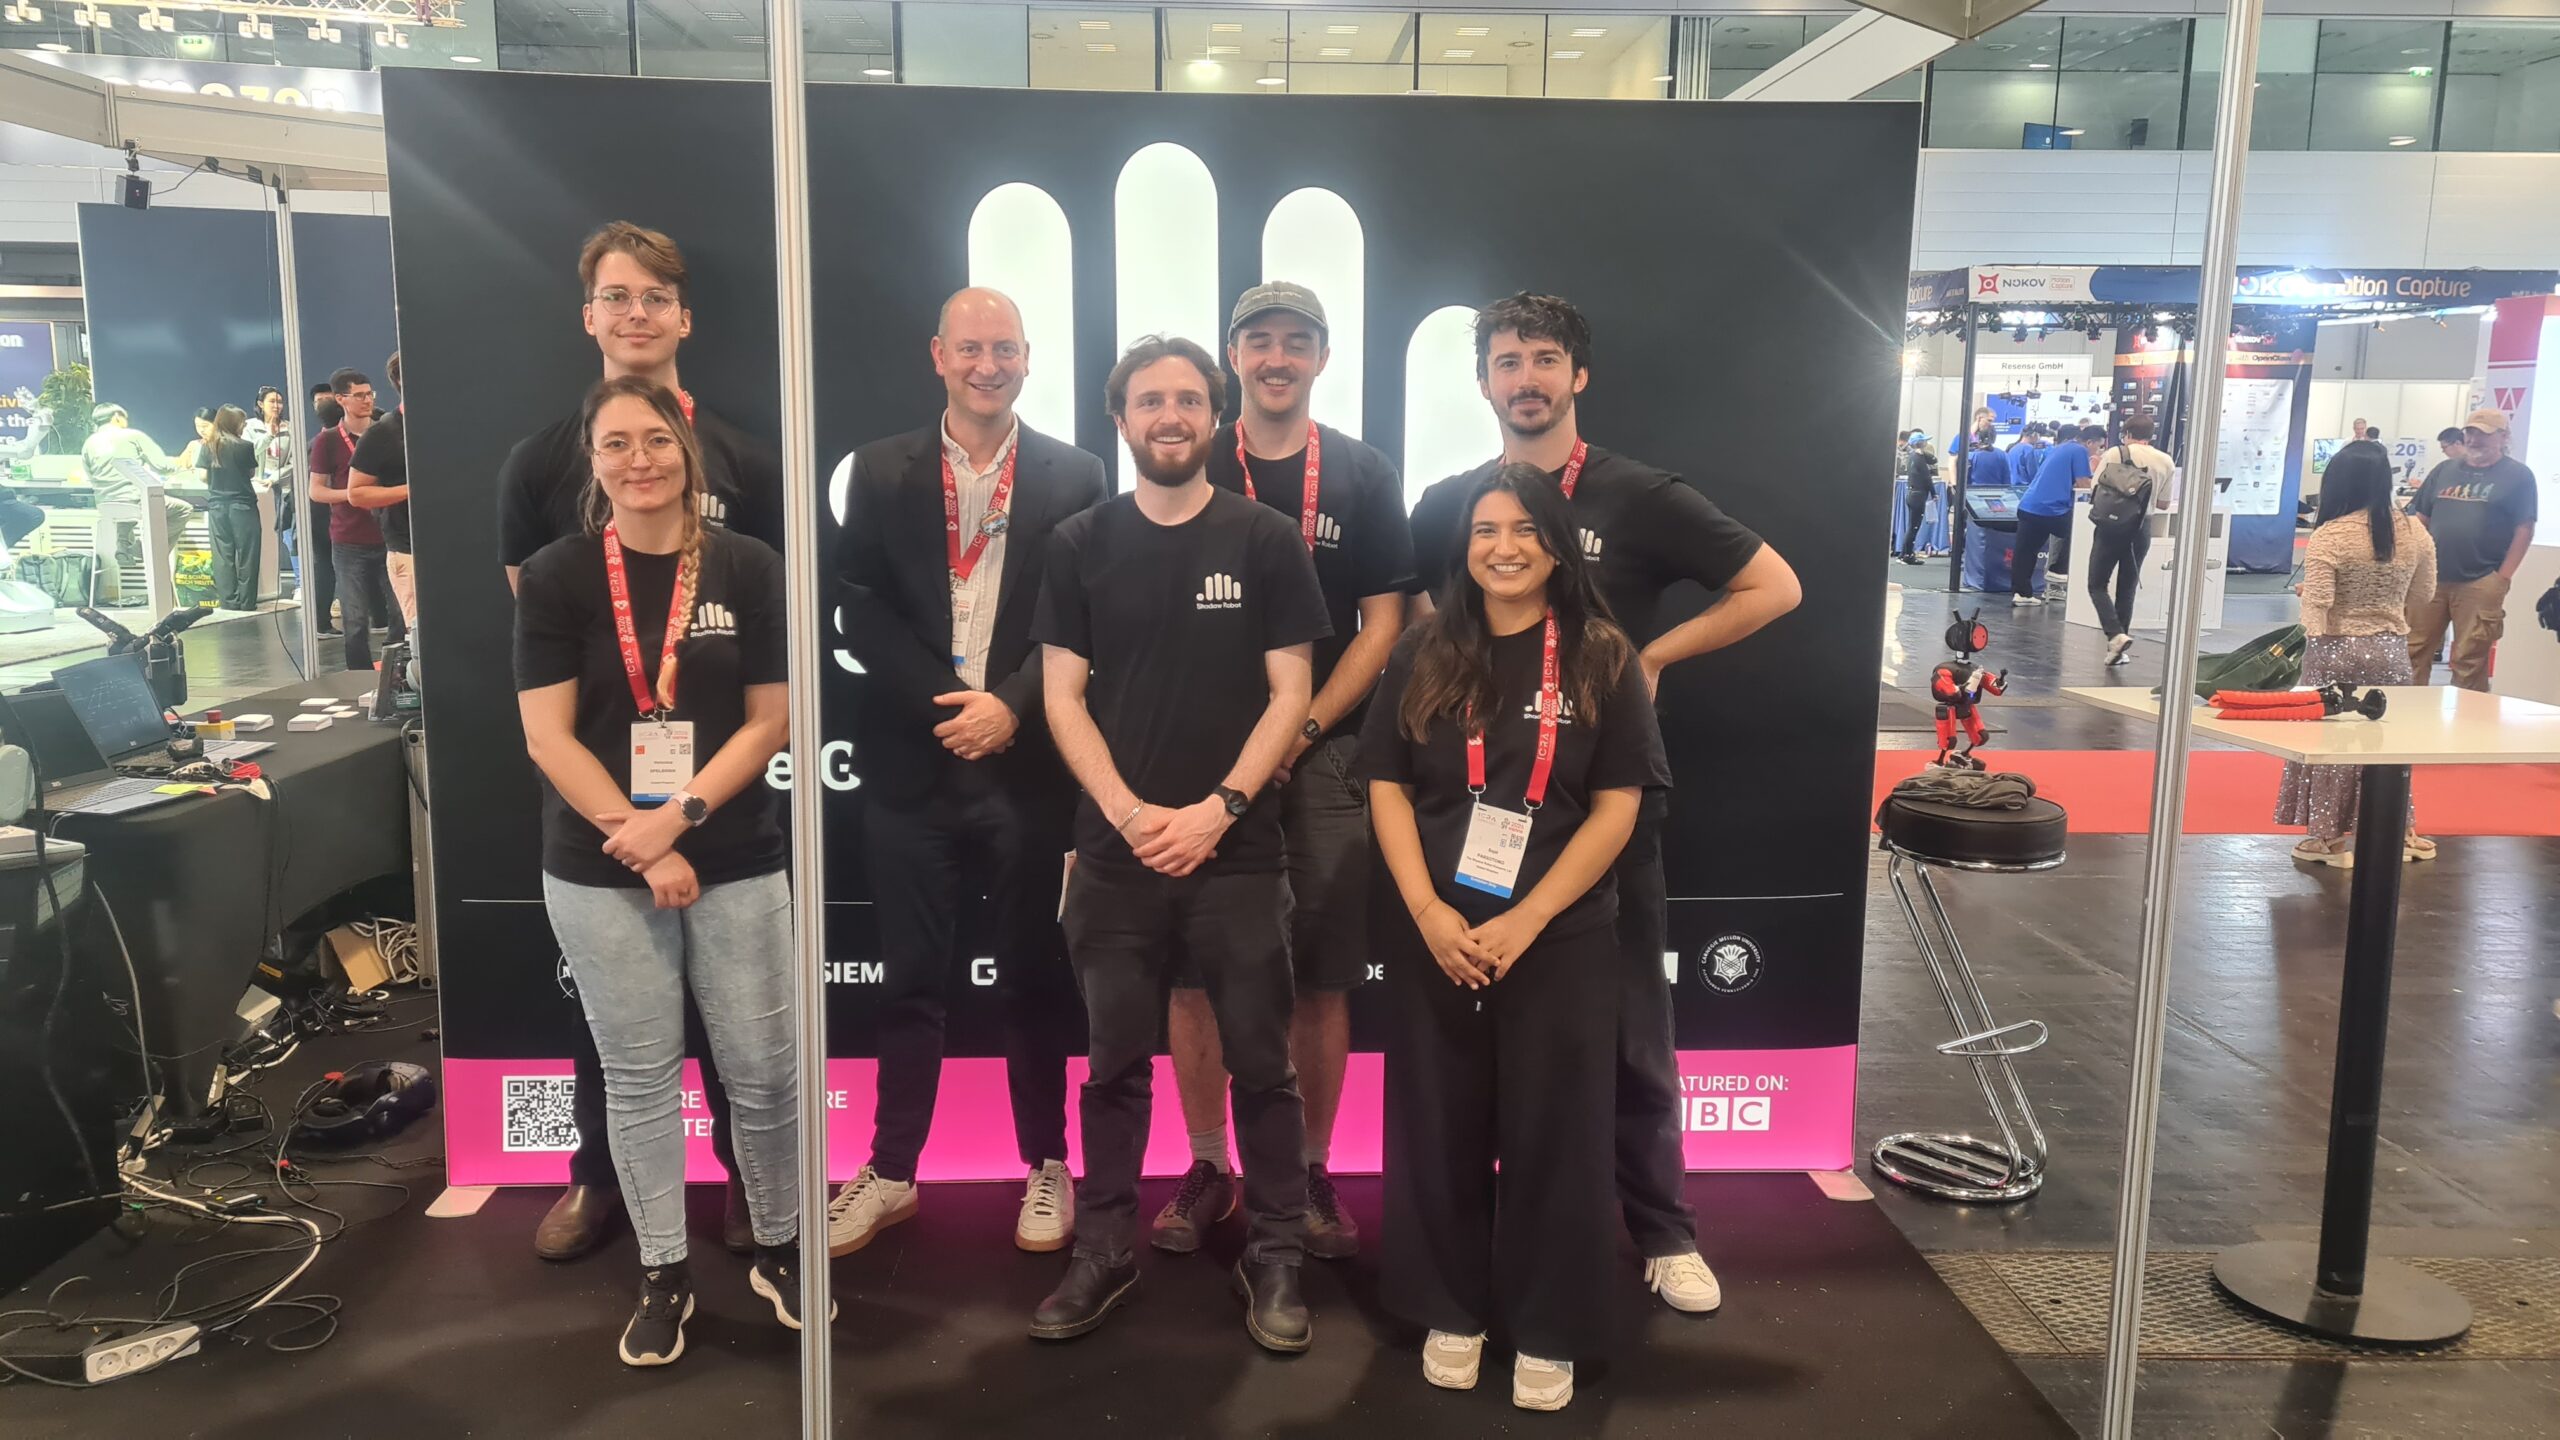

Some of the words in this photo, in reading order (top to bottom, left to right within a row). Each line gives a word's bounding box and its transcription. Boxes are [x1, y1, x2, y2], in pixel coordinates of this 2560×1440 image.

[2003, 278, 2046, 288] NOKOV
[2396, 276, 2471, 299] Capture
[0, 334, 24, 347] on
[2001, 362, 2036, 370] Resense
[2038, 362, 2064, 370] GmbH
[2394, 443, 2417, 456] 20
[1309, 480, 1318, 503] ICRA
[610, 571, 622, 597] ICRA
[616, 615, 627, 634] 2026
[624, 649, 637, 677] ICRA
[1544, 654, 1553, 679] ICRA
[1542, 698, 1551, 716] 2026
[1537, 733, 1549, 761] ICRA
[1718, 935, 1741, 943] MELLON
[1741, 937, 1761, 963] UNIVERSITY
[1755, 1075, 1789, 1091] ON:
[682, 1118, 714, 1137] TE
